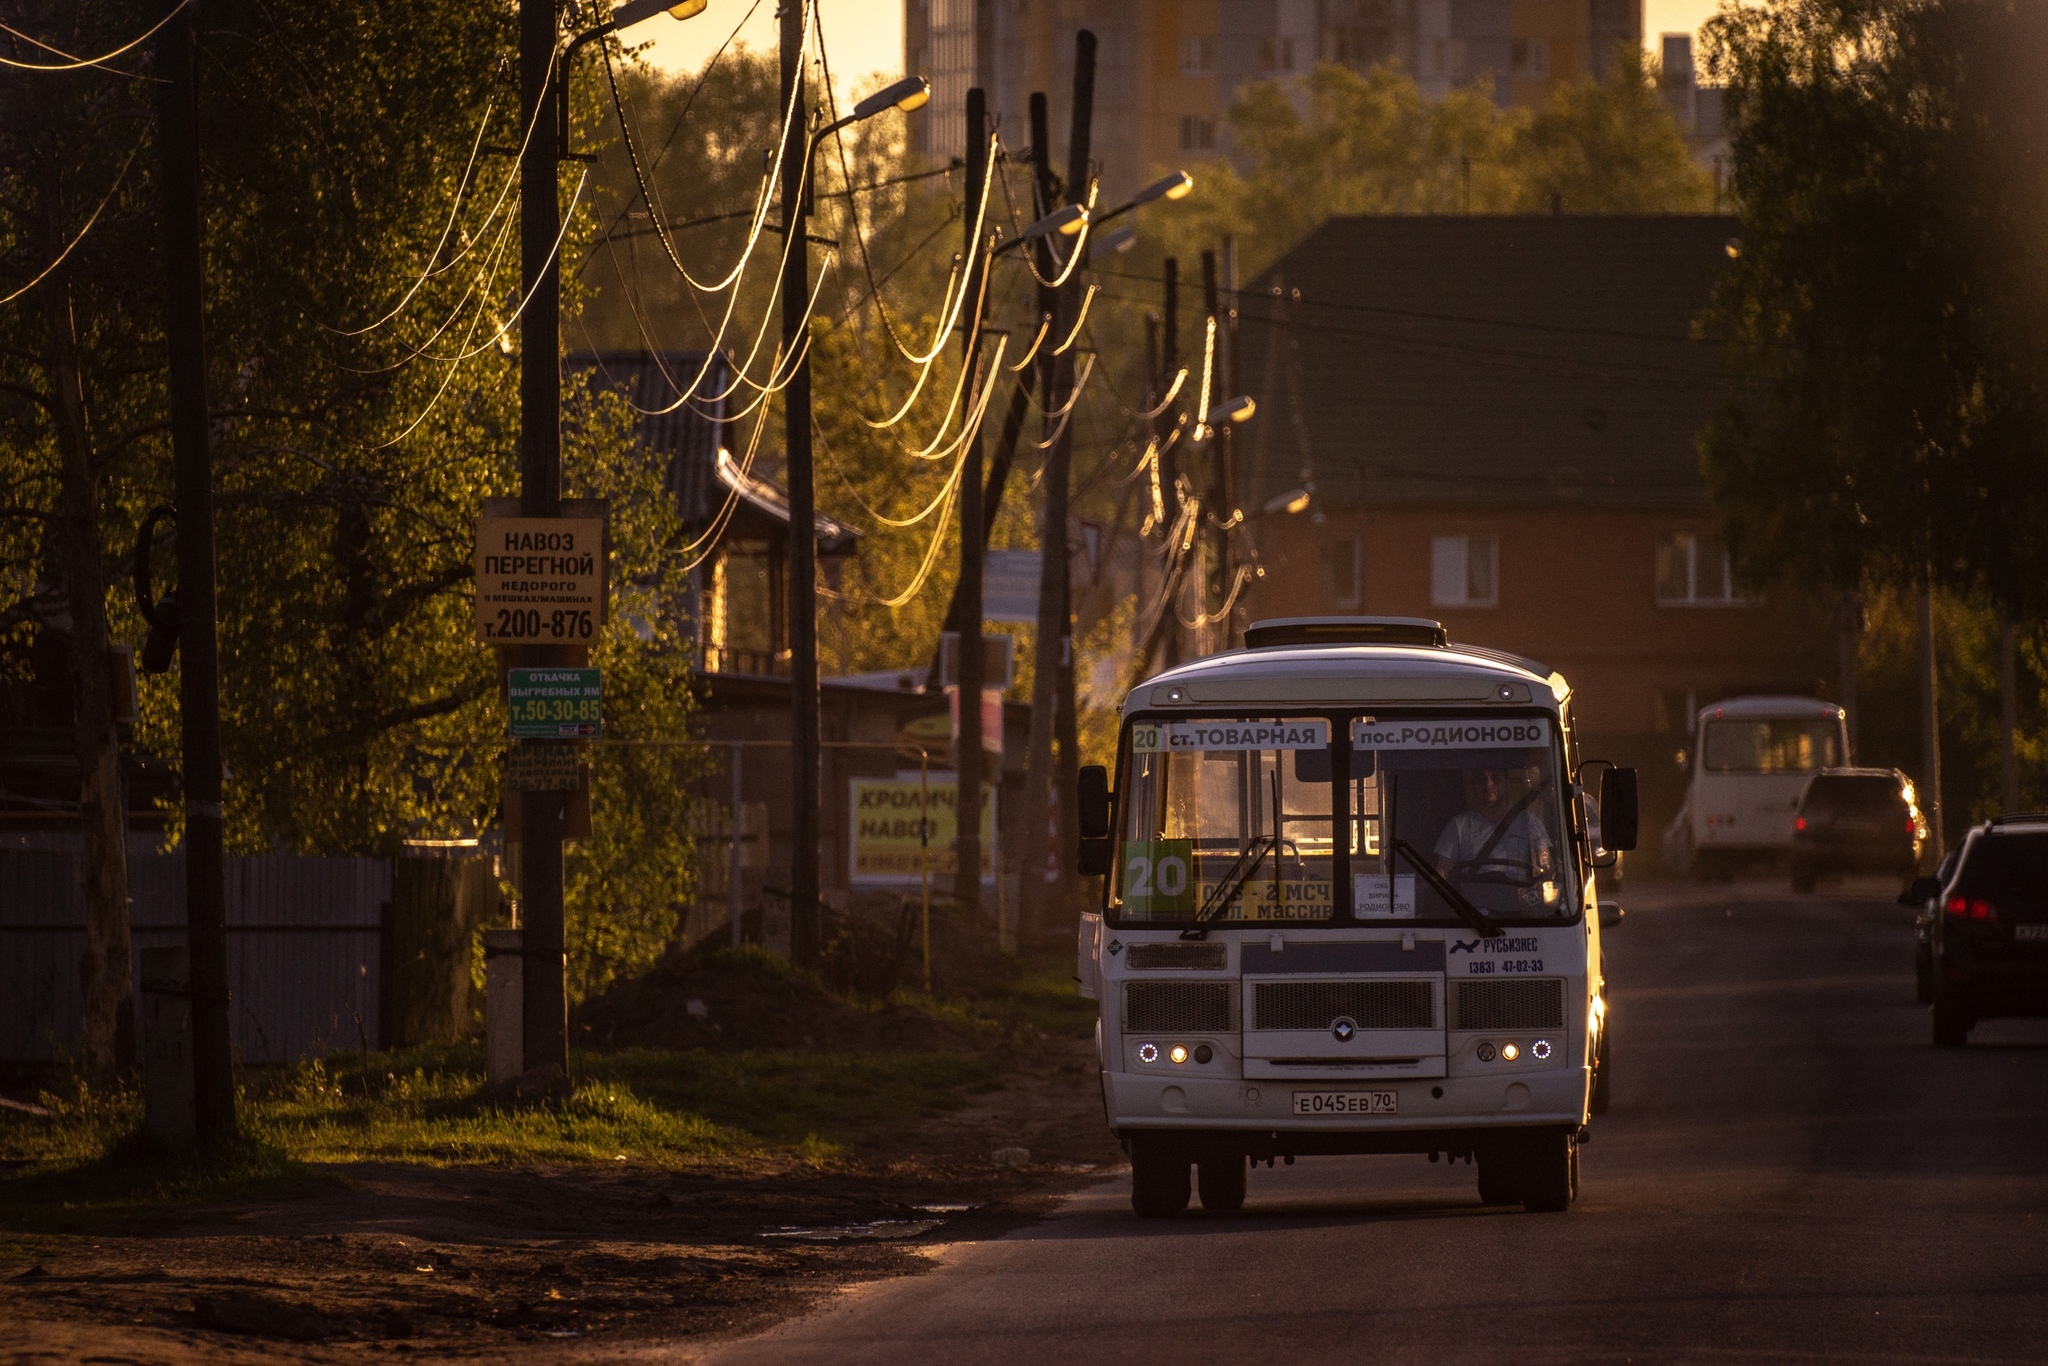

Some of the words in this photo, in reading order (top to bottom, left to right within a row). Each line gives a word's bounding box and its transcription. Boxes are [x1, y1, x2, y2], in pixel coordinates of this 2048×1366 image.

[505, 533, 574, 551] НАВОЗ
[485, 552, 593, 575] ПЕРЕГНОЙ
[501, 581, 576, 592] НЕДОРОГО
[484, 609, 593, 638] т.200-876
[530, 673, 580, 682] ОТКАЧКА
[511, 688, 580, 697] ВЫГРЕБНЫХ
[584, 687, 600, 696] ЯМ
[512, 699, 600, 721] т.50-30-85
[1134, 730, 1157, 748] 20
[1126, 855, 1187, 897] 20
[1266, 884, 1278, 901] 2
[1286, 883, 1330, 901] МСЧ
[1484, 938, 1538, 953] РУСБИЗНЕС
[1469, 961, 1495, 973] (383)
[1502, 959, 1543, 972] 47-02-33
[1300, 1094, 1369, 1112] Е045ЕВ
[1374, 1094, 1391, 1107] 70
